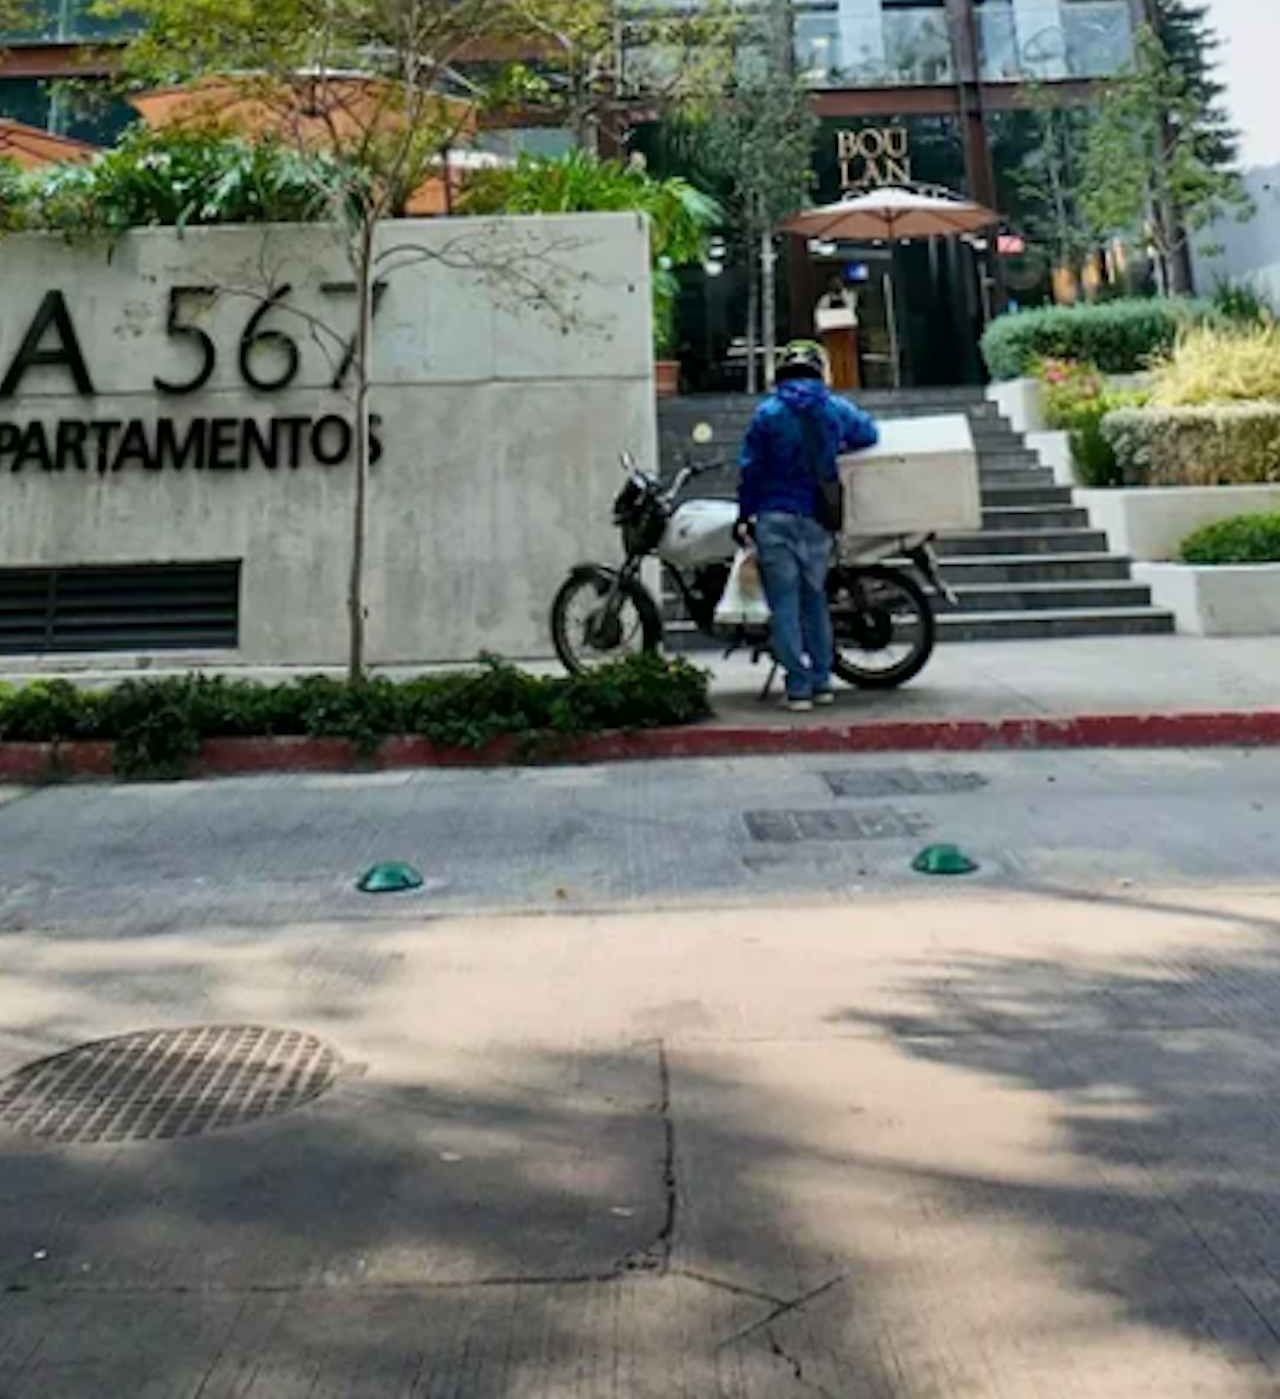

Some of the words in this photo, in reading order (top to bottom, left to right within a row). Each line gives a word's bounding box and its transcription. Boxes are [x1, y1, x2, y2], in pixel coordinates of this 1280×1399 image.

[837, 127, 908, 159] BOU
[839, 156, 911, 186] LAN
[153, 282, 388, 395] 567
